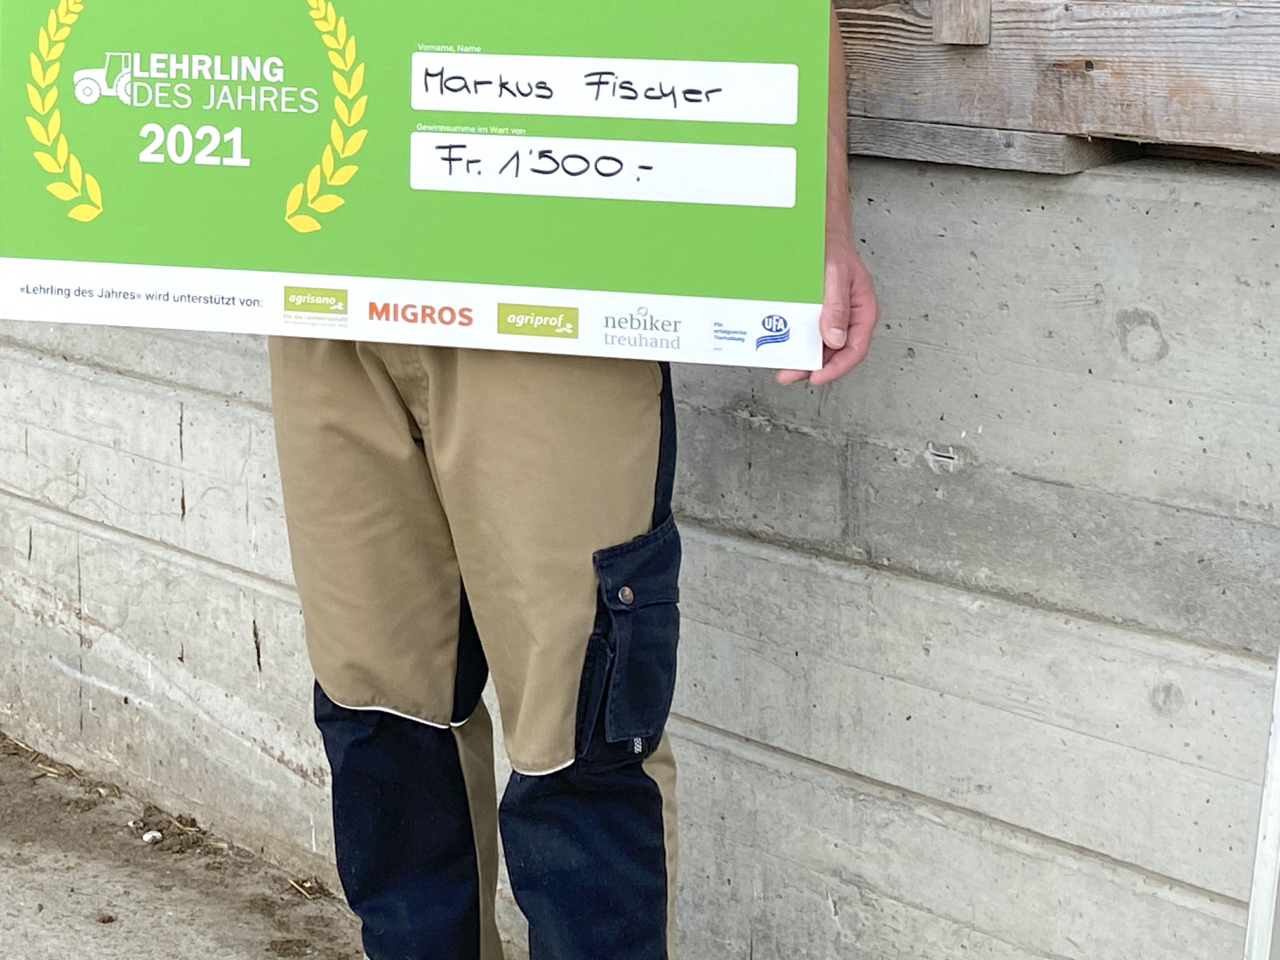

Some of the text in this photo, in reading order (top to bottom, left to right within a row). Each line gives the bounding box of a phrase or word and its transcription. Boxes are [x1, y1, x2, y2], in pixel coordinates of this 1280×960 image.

[417, 43, 481, 53] Vorname, Name
[133, 53, 284, 82] LEHRLING
[423, 66, 723, 109] Markus Fischer
[133, 82, 320, 115] DES JAHRES
[416, 123, 476, 133] Gewinnsumme
[477, 126, 488, 134] im
[489, 126, 509, 134] Wert
[138, 123, 251, 167] 2021
[435, 144, 482, 176] Fr.
[20, 284, 264, 307] «Lehrling des Jahres» wird unterstützt von:
[288, 293, 336, 306] agrisano
[368, 302, 474, 327] MIGROS
[507, 312, 564, 327] agriprof
[604, 313, 682, 333] nebiker
[763, 315, 786, 332] UFA
[604, 332, 681, 350] treuhand
